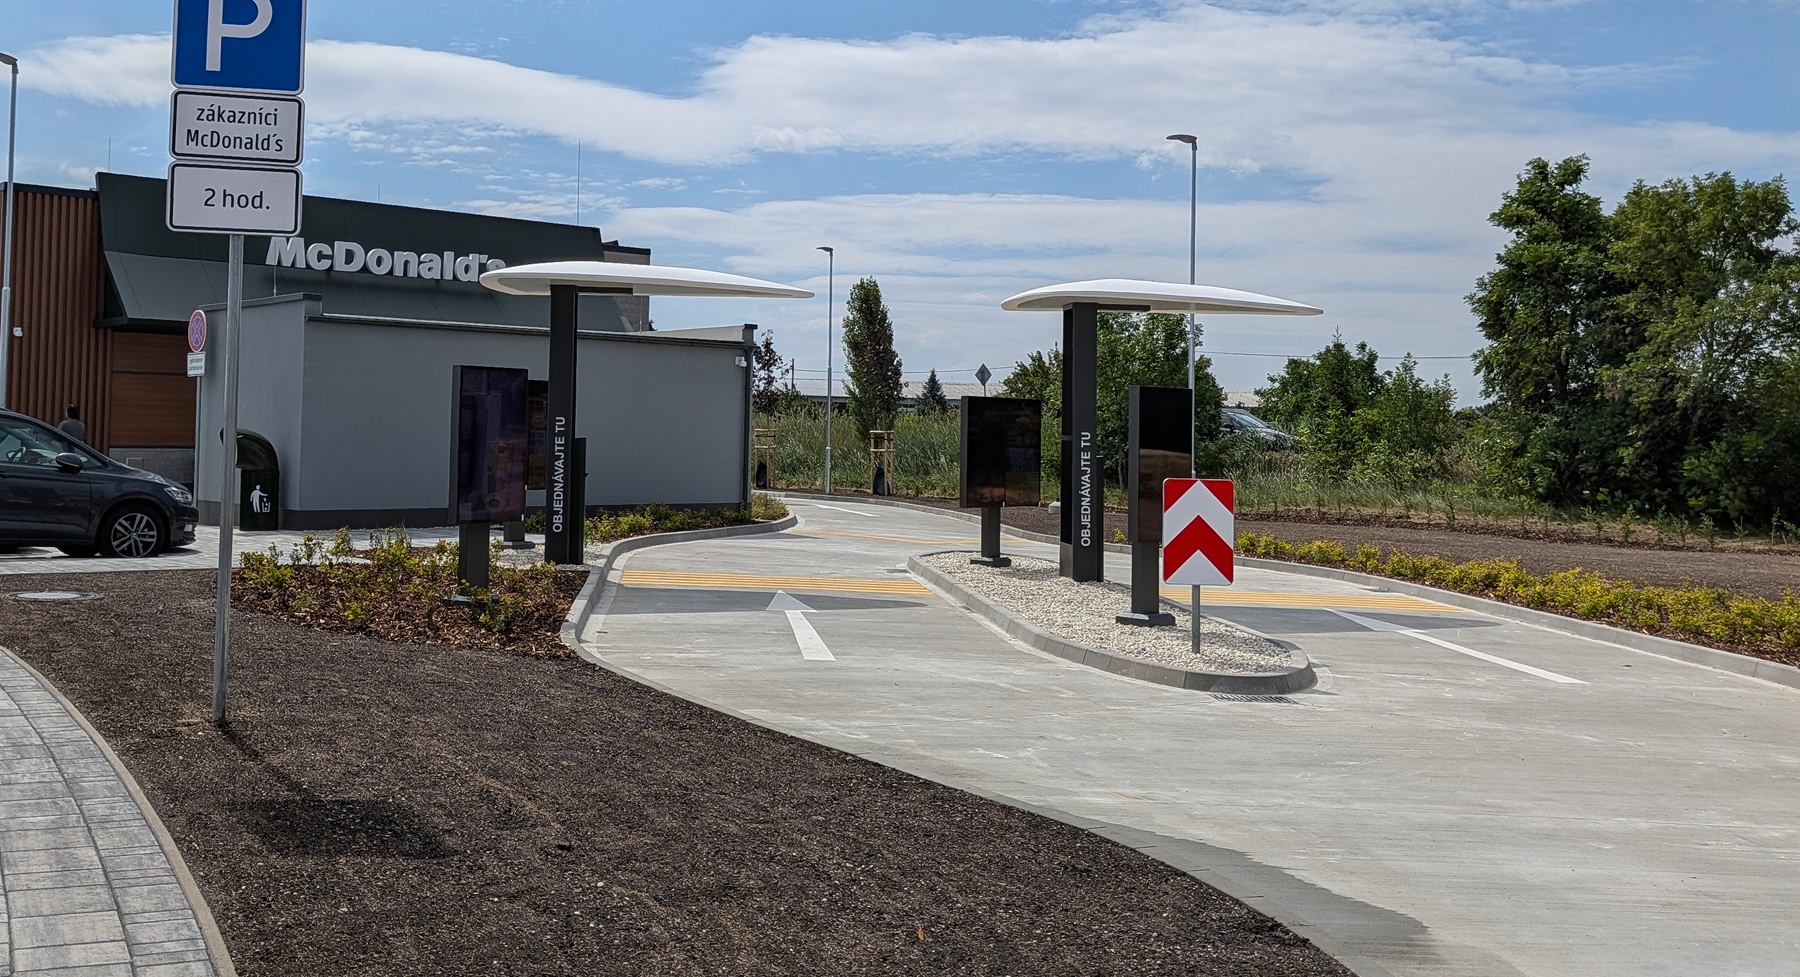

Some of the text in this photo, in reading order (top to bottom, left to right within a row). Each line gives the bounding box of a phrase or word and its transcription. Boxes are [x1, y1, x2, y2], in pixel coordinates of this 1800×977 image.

[205, 0, 273, 72] P
[196, 104, 278, 126] zákazníci
[203, 188, 270, 210] 2 hod.
[552, 416, 566, 533] OBJEDNÁVAJTE TU
[1079, 431, 1091, 547] OBJEDNÁVAJTE TU
